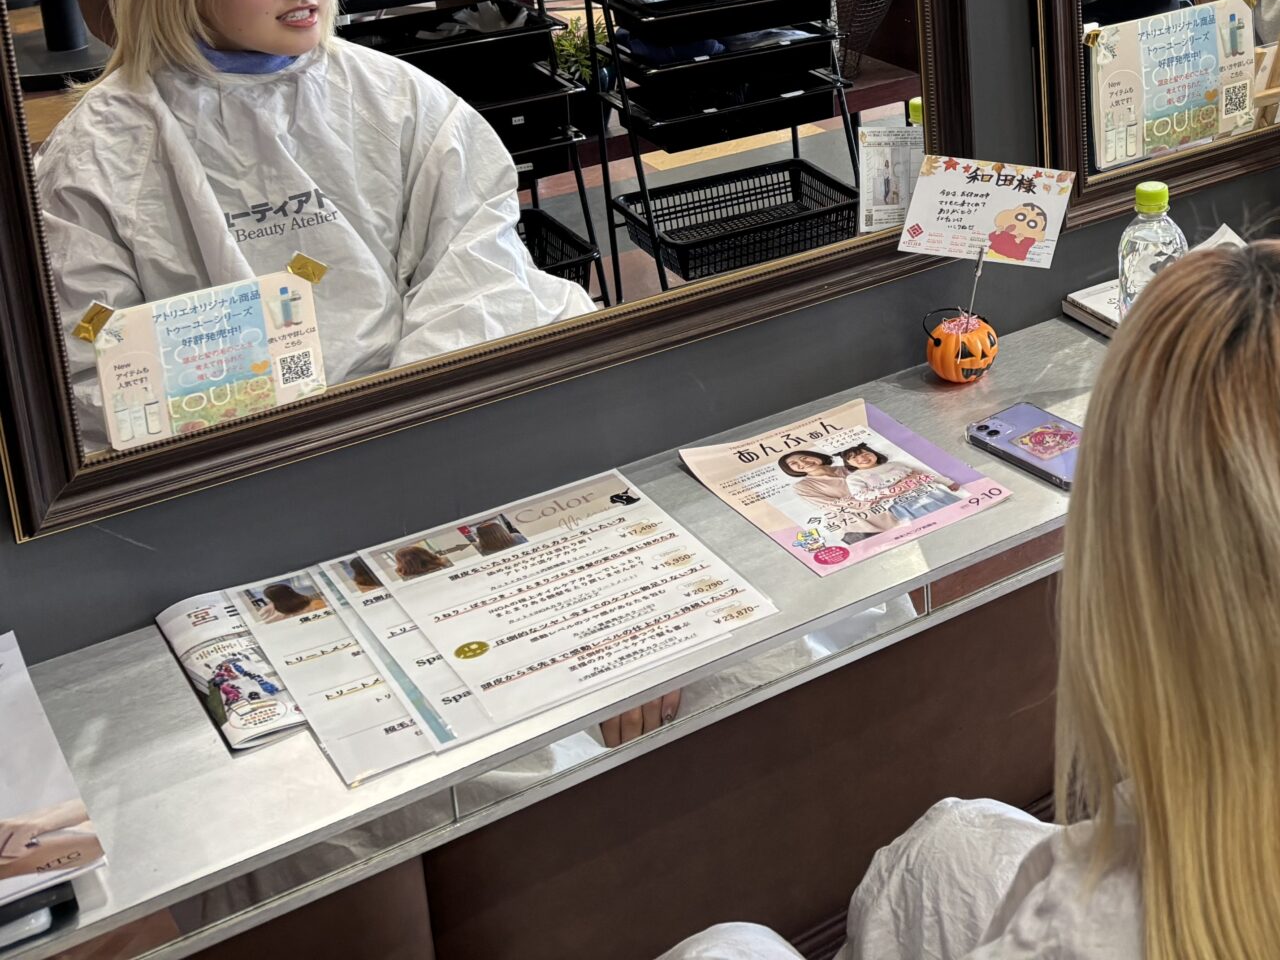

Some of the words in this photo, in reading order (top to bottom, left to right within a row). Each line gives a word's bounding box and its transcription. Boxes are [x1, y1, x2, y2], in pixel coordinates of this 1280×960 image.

[1138, 16, 1216, 40] アトリエオリジナル商品
[1109, 88, 1134, 98] アイテムも
[965, 167, 1037, 195] 和田様
[235, 222, 285, 242] Beauty
[291, 210, 338, 230] Atelier
[152, 290, 260, 323] アトリエオリジナル商品
[113, 362, 131, 371] New
[115, 367, 149, 380] アイテムも
[733, 420, 844, 465] あんふぁん
[514, 491, 597, 525] Color
[449, 517, 626, 581] 頭皮をいたわりながらカラーをしたい方
